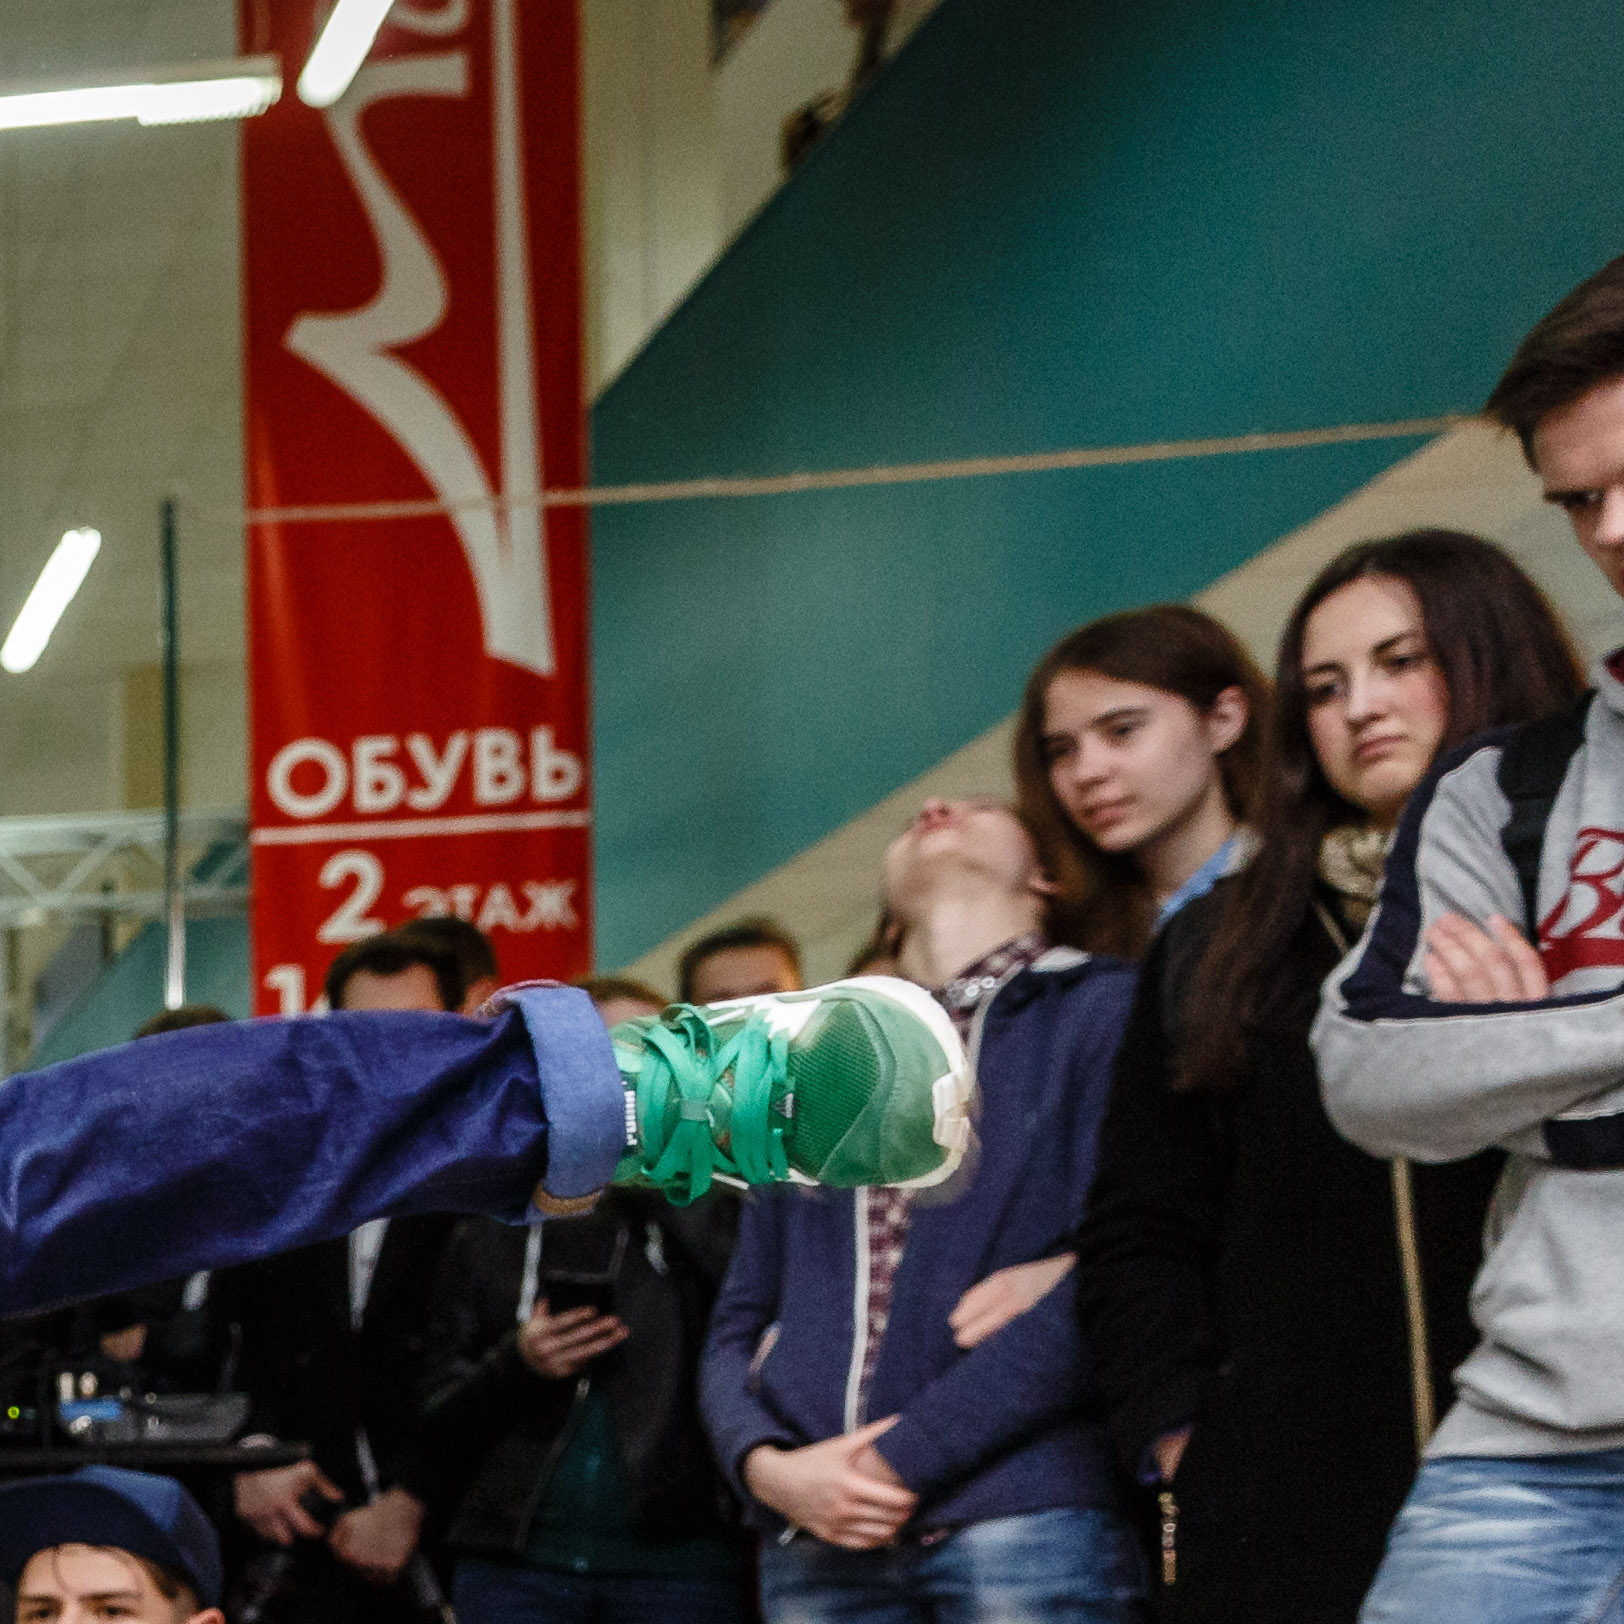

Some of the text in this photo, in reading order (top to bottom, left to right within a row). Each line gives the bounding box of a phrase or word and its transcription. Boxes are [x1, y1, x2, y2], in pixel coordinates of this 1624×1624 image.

[266, 724, 584, 820] ОБУВЬ
[316, 850, 580, 945] 2 ЭТАЖ
